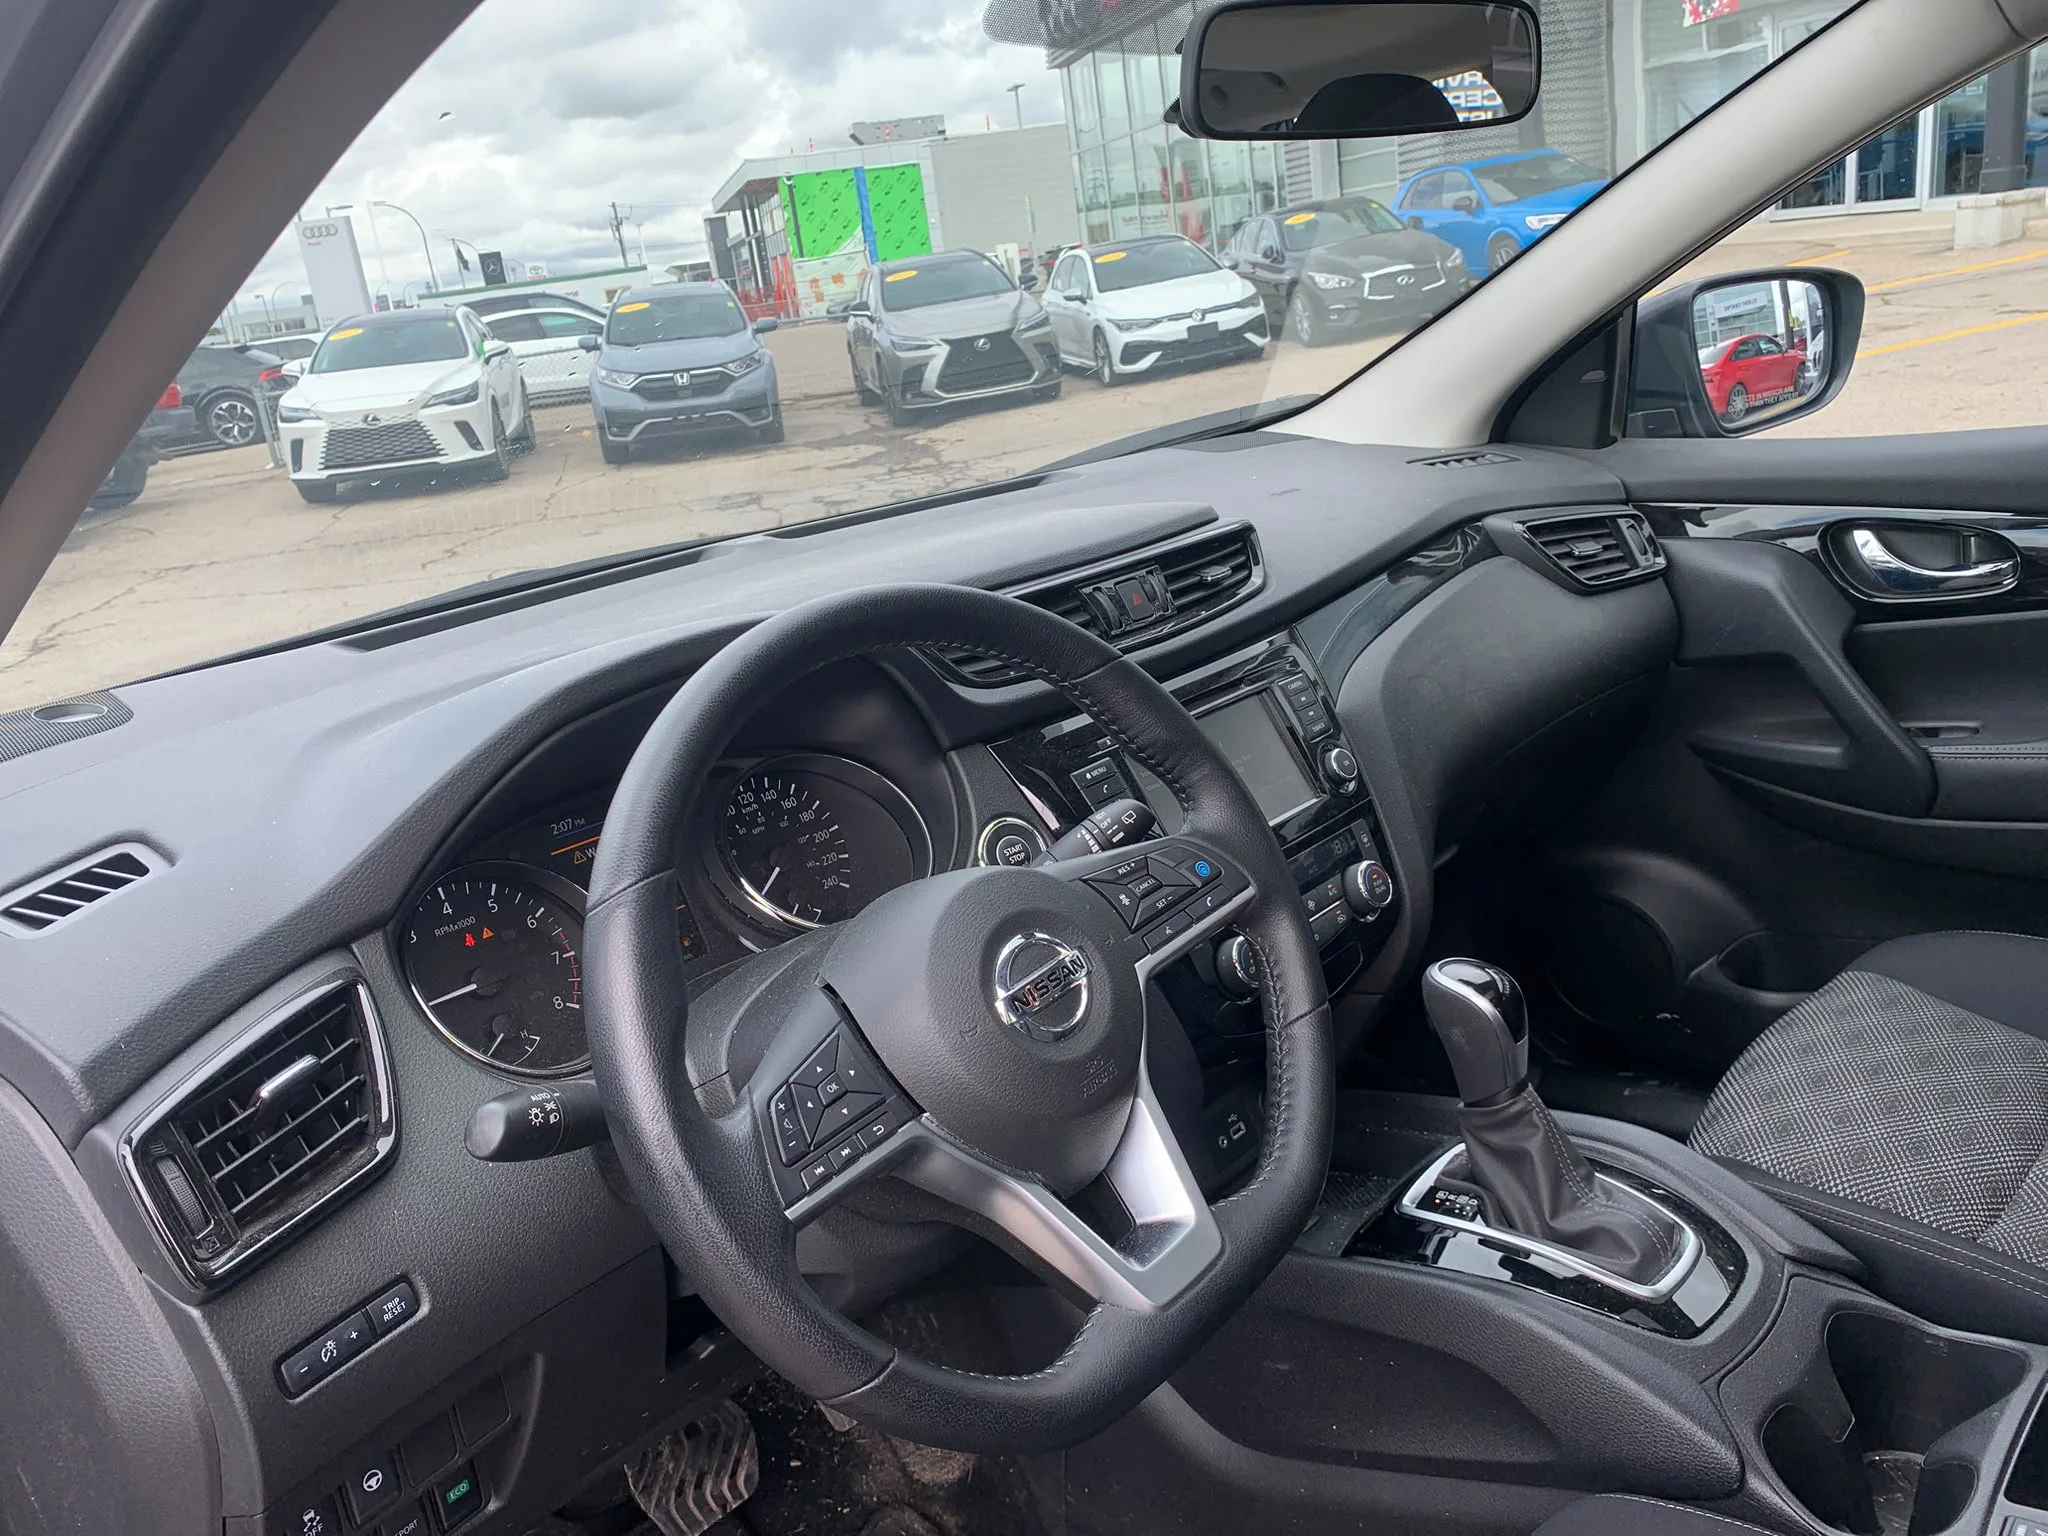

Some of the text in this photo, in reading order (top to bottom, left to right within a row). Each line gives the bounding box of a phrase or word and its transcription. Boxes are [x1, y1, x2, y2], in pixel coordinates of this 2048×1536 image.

[1090, 765, 1107, 777] MENU
[738, 791, 754, 805] 120
[760, 789, 777, 802] 140
[741, 803, 759, 814] km/h
[781, 796, 797, 810] 160
[799, 809, 815, 823] 180
[1099, 817, 1112, 829] OFF
[551, 818, 572, 835] 2:07
[738, 827, 747, 835] 60
[751, 825, 766, 835] MPH
[813, 829, 830, 843] 200
[1003, 843, 1024, 857] START
[821, 852, 838, 866] 220
[1008, 851, 1026, 864] STOP
[822, 875, 839, 889] 240
[1135, 877, 1156, 893] CANCEL
[442, 902, 453, 915] 4
[487, 899, 498, 913] 5
[434, 916, 477, 937] RPMx1000
[526, 915, 537, 929] 6
[551, 950, 560, 964] 7
[1011, 956, 1087, 1016] NISSAN
[552, 995, 564, 1009] 8
[519, 1028, 529, 1039] H
[826, 1080, 841, 1095] OK
[530, 1092, 551, 1102] AUTO
[382, 1296, 401, 1313] TRIP
[383, 1302, 407, 1323] RESET
[449, 1481, 468, 1502] ECO
[304, 1523, 325, 1536] OFF
